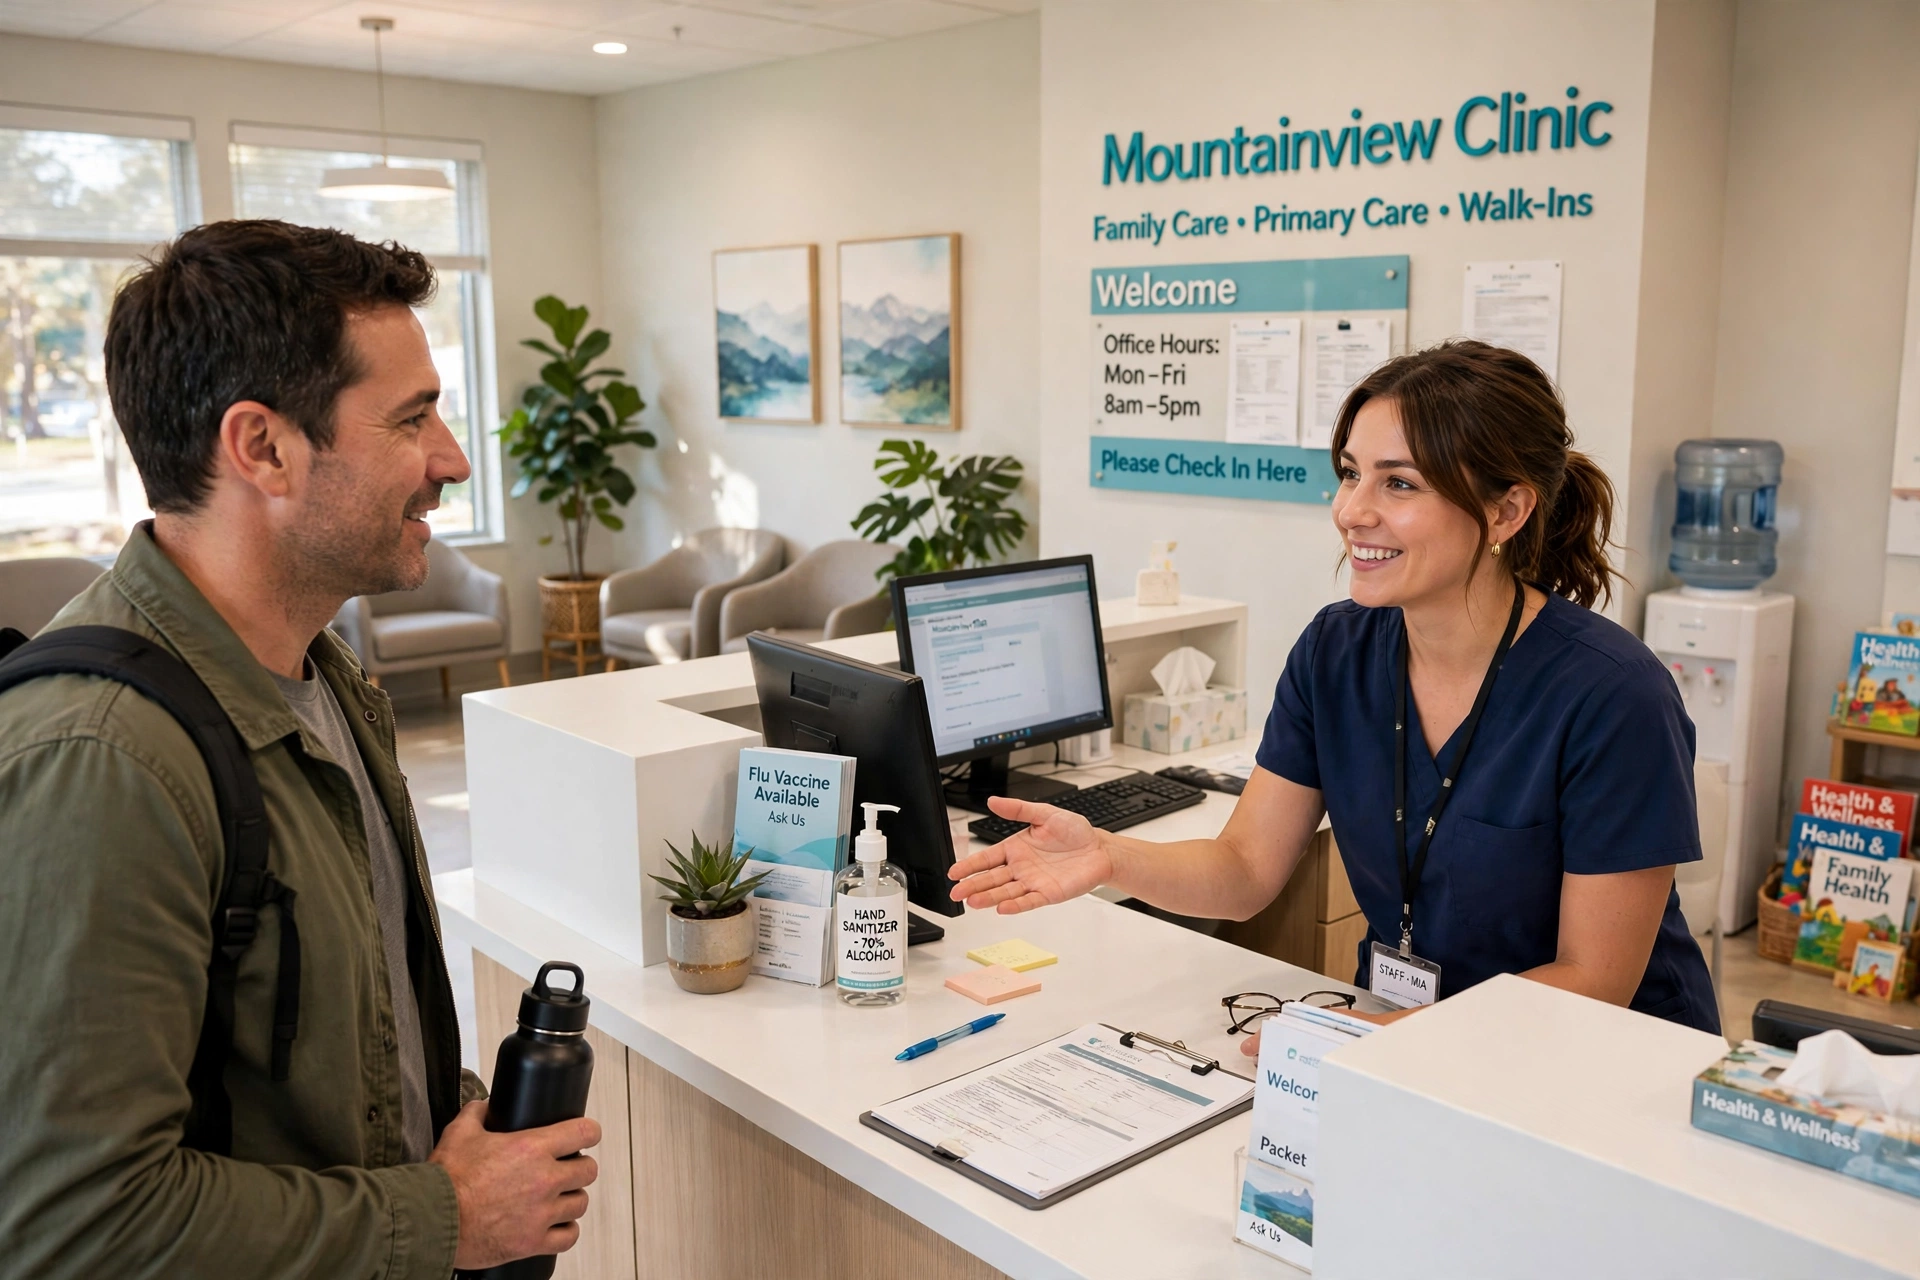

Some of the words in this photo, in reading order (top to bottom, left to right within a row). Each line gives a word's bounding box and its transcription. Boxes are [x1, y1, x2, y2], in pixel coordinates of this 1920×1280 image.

[1101, 109, 1441, 186] Mountainview
[1453, 86, 1614, 157] Clinic
[1094, 214, 1165, 246] Family
[1171, 210, 1228, 239] Care
[1254, 203, 1355, 236] Primary
[1362, 198, 1429, 228] Care
[1459, 187, 1594, 222] Walk-Ins
[1096, 273, 1238, 307] Welcome
[1104, 333, 1155, 354] Office
[1161, 333, 1219, 354] Hours:
[1101, 450, 1160, 475] Please
[1165, 453, 1226, 479] Check
[1231, 456, 1250, 480] In
[1257, 458, 1307, 483] Here
[1861, 637, 1920, 659] Health
[749, 766, 770, 783] Flu
[774, 770, 831, 790] Vaccine
[754, 786, 820, 808] Available
[1810, 784, 1875, 811] Health
[1878, 796, 1895, 815] &
[768, 810, 788, 824] Ask
[791, 812, 806, 827] Us
[1811, 801, 1895, 831] Wellness
[1800, 822, 1866, 852] Health
[1868, 836, 1885, 856] &
[1827, 856, 1892, 887] Family
[1824, 876, 1889, 905] Health
[843, 920, 898, 934] SANITIZER
[854, 909, 886, 920] HAND
[846, 948, 896, 962] ALCOHOL
[861, 937, 885, 949] 70%
[1379, 963, 1405, 981] STAFF
[1410, 976, 1427, 991] MIA
[1702, 1089, 1760, 1122] Health
[1762, 1108, 1777, 1128] &
[1780, 1112, 1861, 1153] Wellness
[1260, 1135, 1307, 1168] Packet
[1249, 1221, 1267, 1237] Ask
[1269, 1228, 1281, 1243] Us
